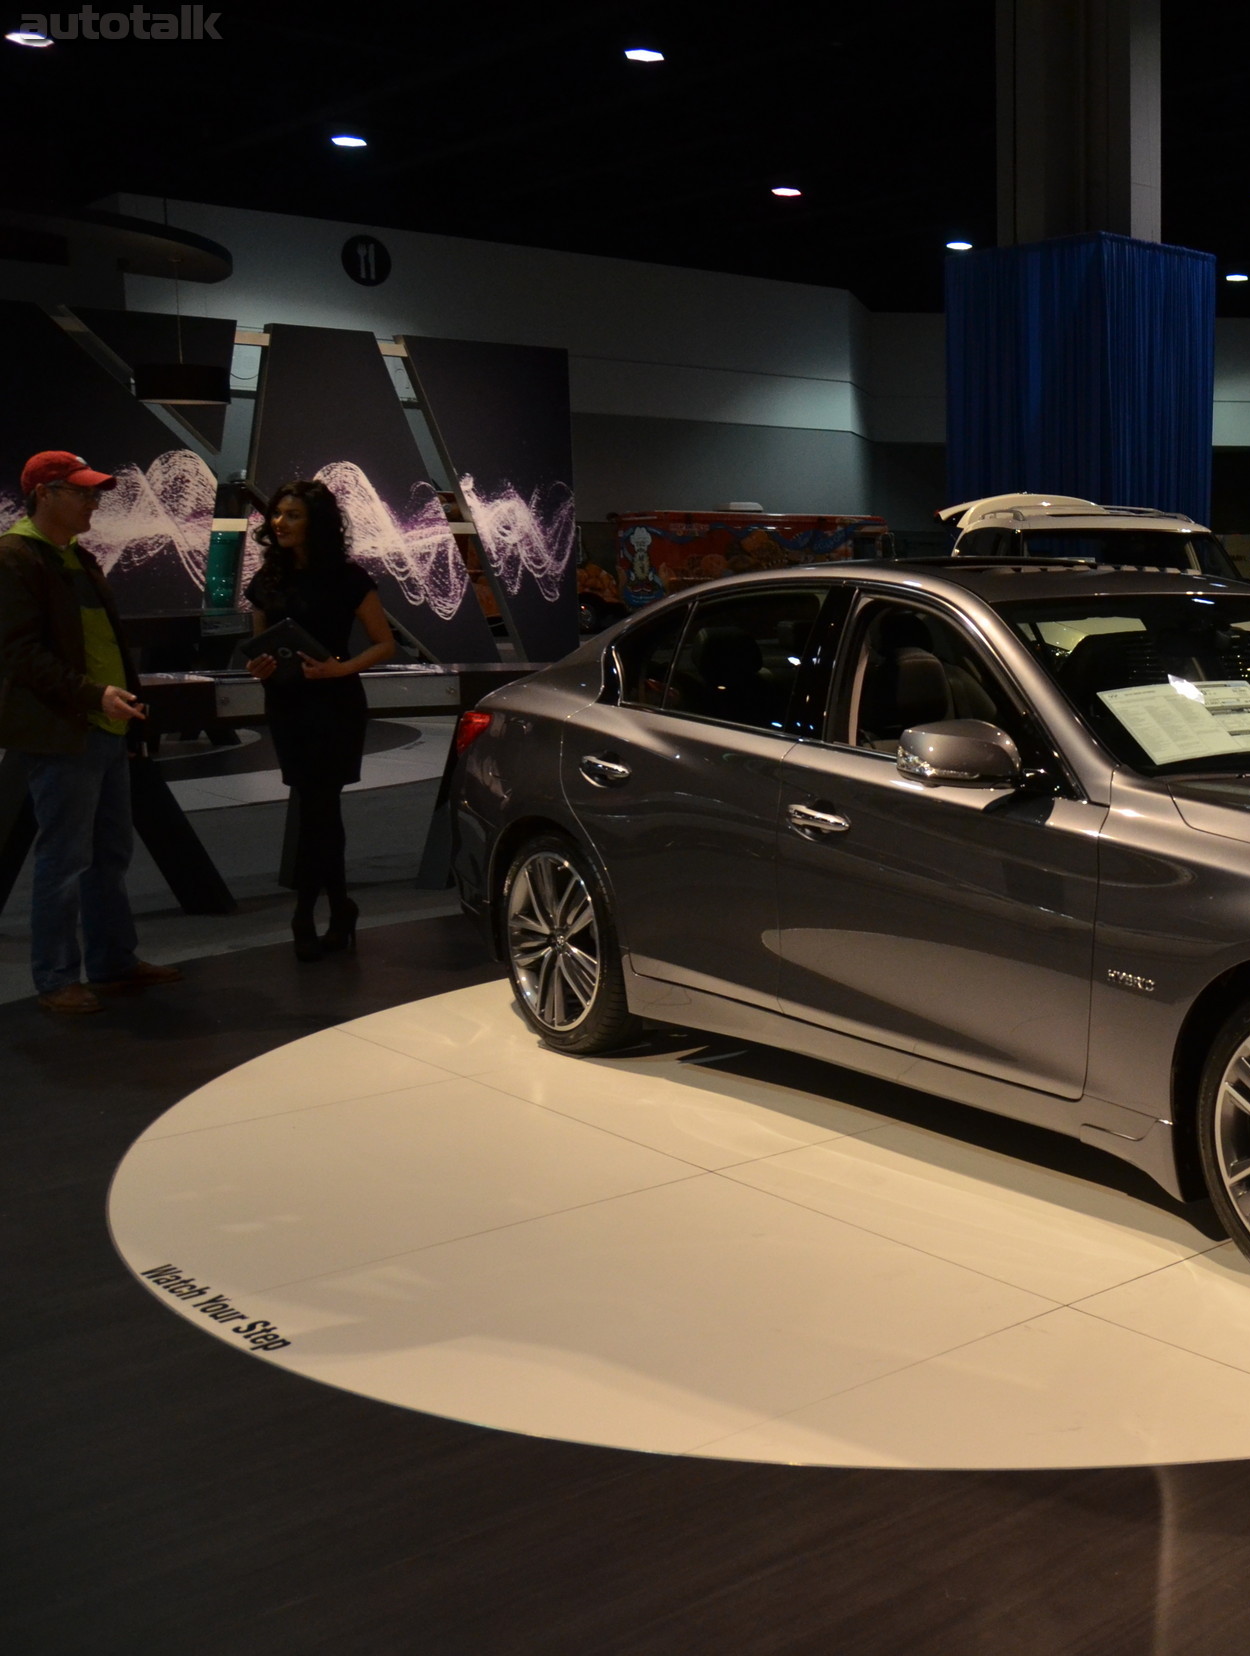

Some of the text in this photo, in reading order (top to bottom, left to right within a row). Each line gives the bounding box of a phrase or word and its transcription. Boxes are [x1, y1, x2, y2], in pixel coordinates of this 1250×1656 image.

[141, 1264, 291, 1351] Watch Your Step
